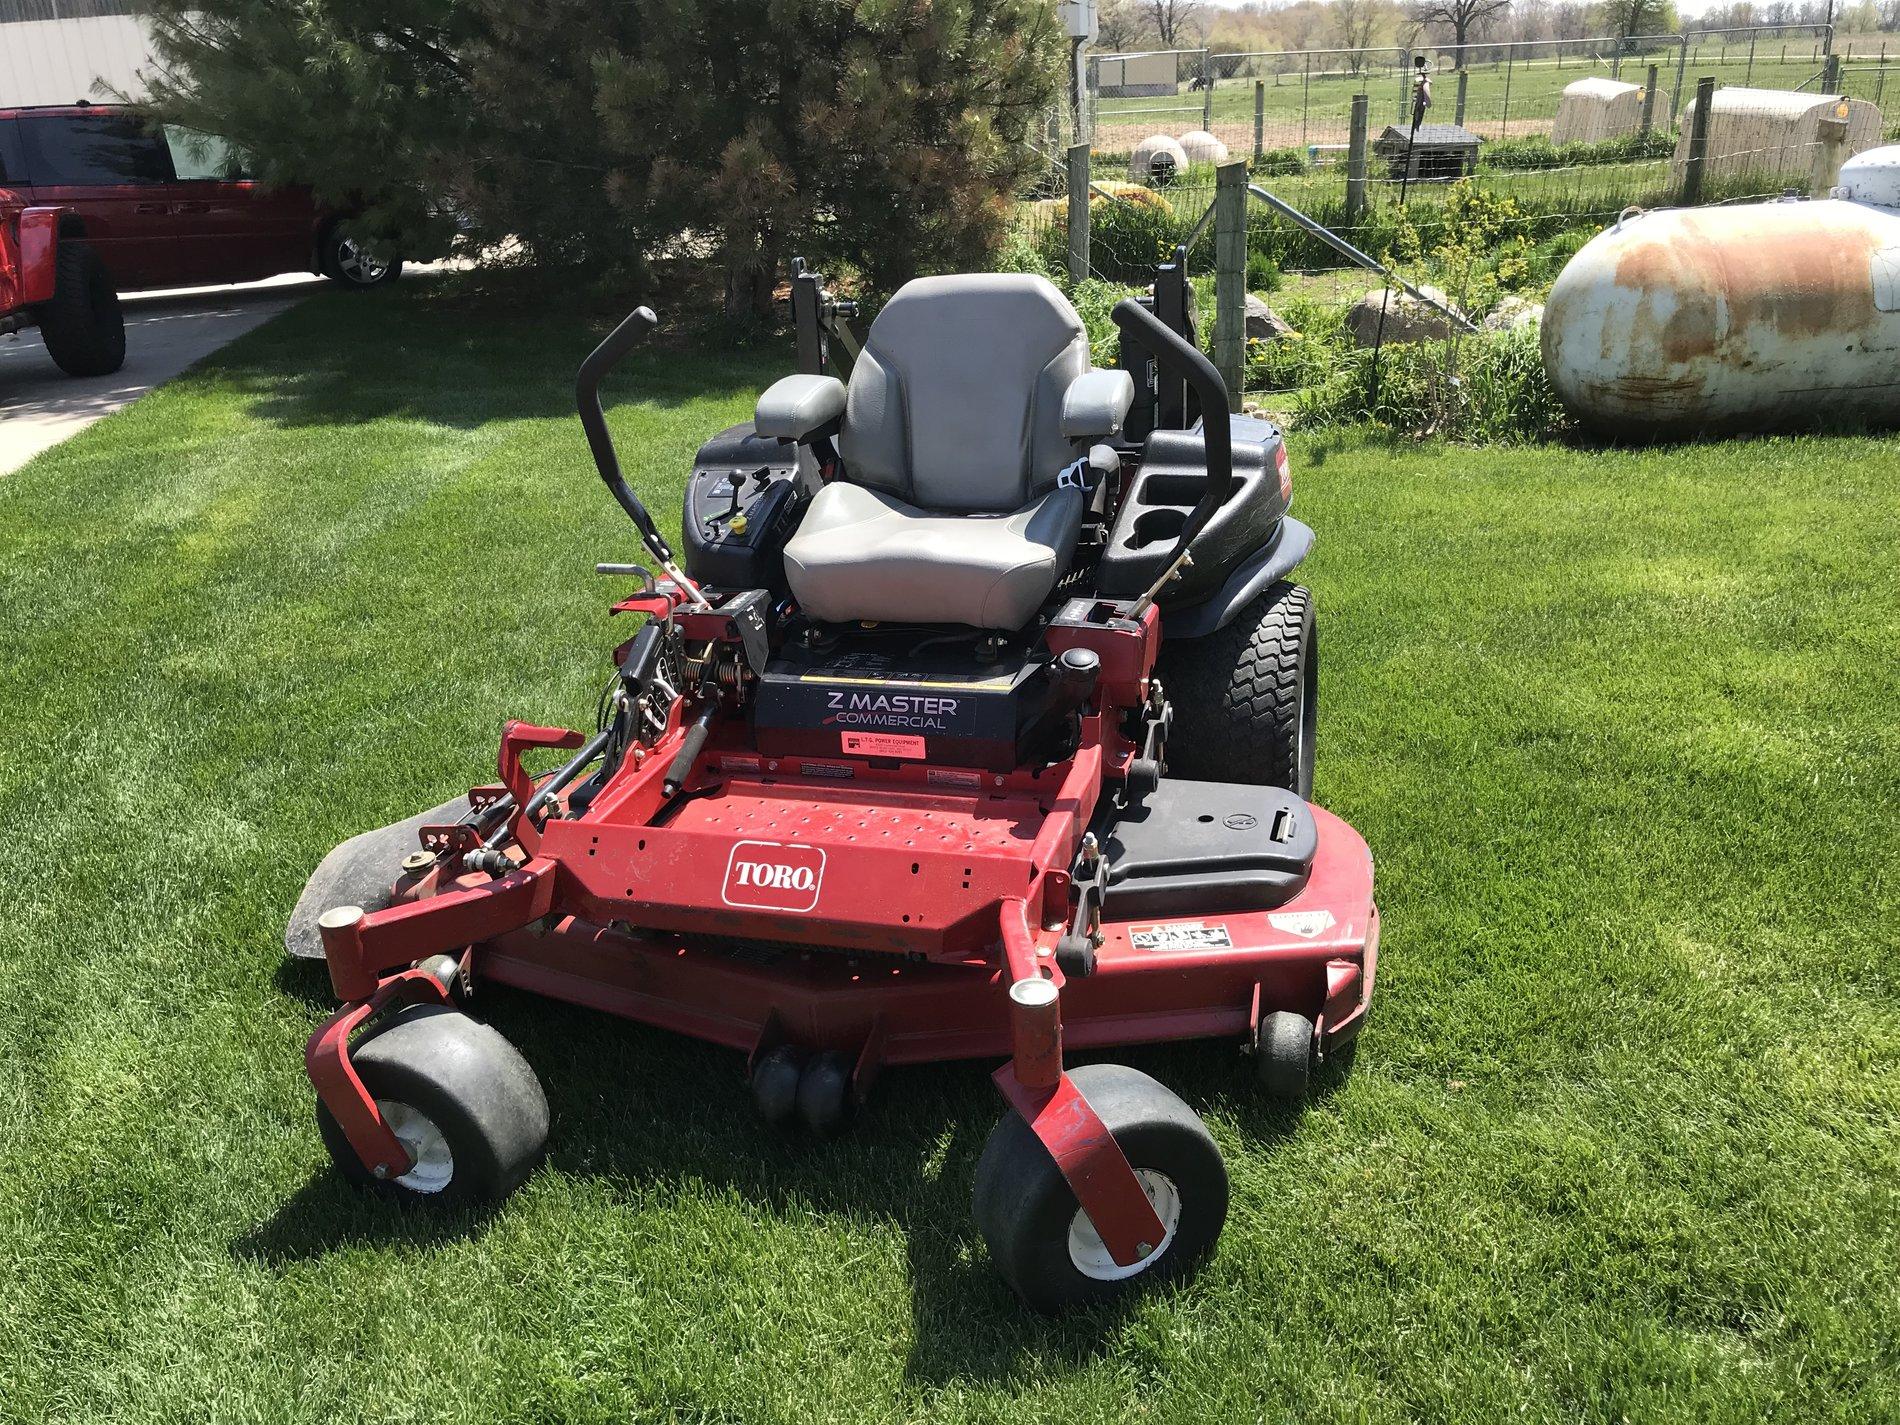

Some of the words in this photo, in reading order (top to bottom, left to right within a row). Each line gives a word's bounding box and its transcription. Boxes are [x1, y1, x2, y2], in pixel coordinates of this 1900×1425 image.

[827, 691, 844, 709] Z
[849, 693, 958, 716] MASTER
[836, 712, 947, 729] COMMERCIAL
[875, 737, 891, 745] POWER
[892, 738, 920, 747] EQUIPMENT
